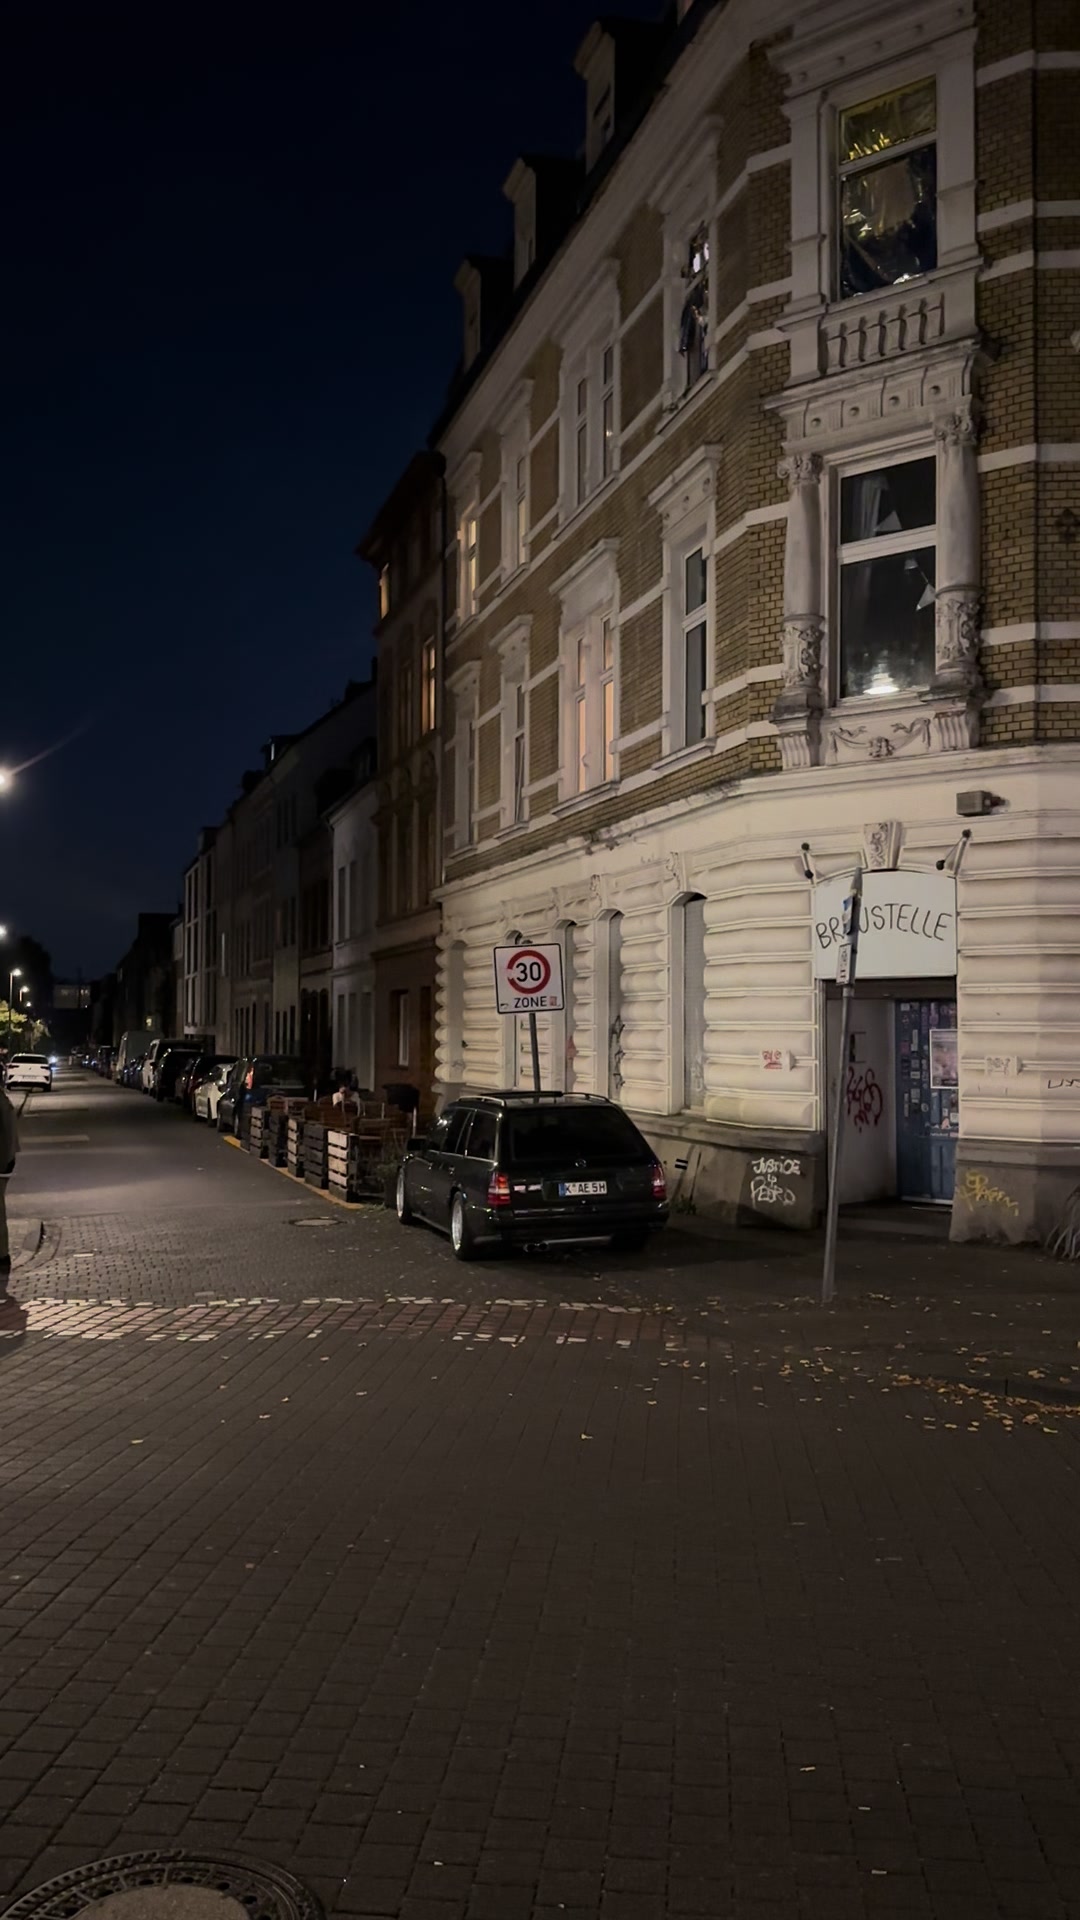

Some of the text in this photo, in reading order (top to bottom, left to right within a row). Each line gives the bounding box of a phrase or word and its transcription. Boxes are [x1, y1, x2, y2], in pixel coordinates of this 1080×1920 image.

[815, 903, 952, 949] BRUSTELLE
[516, 961, 542, 983] 30
[514, 995, 548, 1009] ZONE
